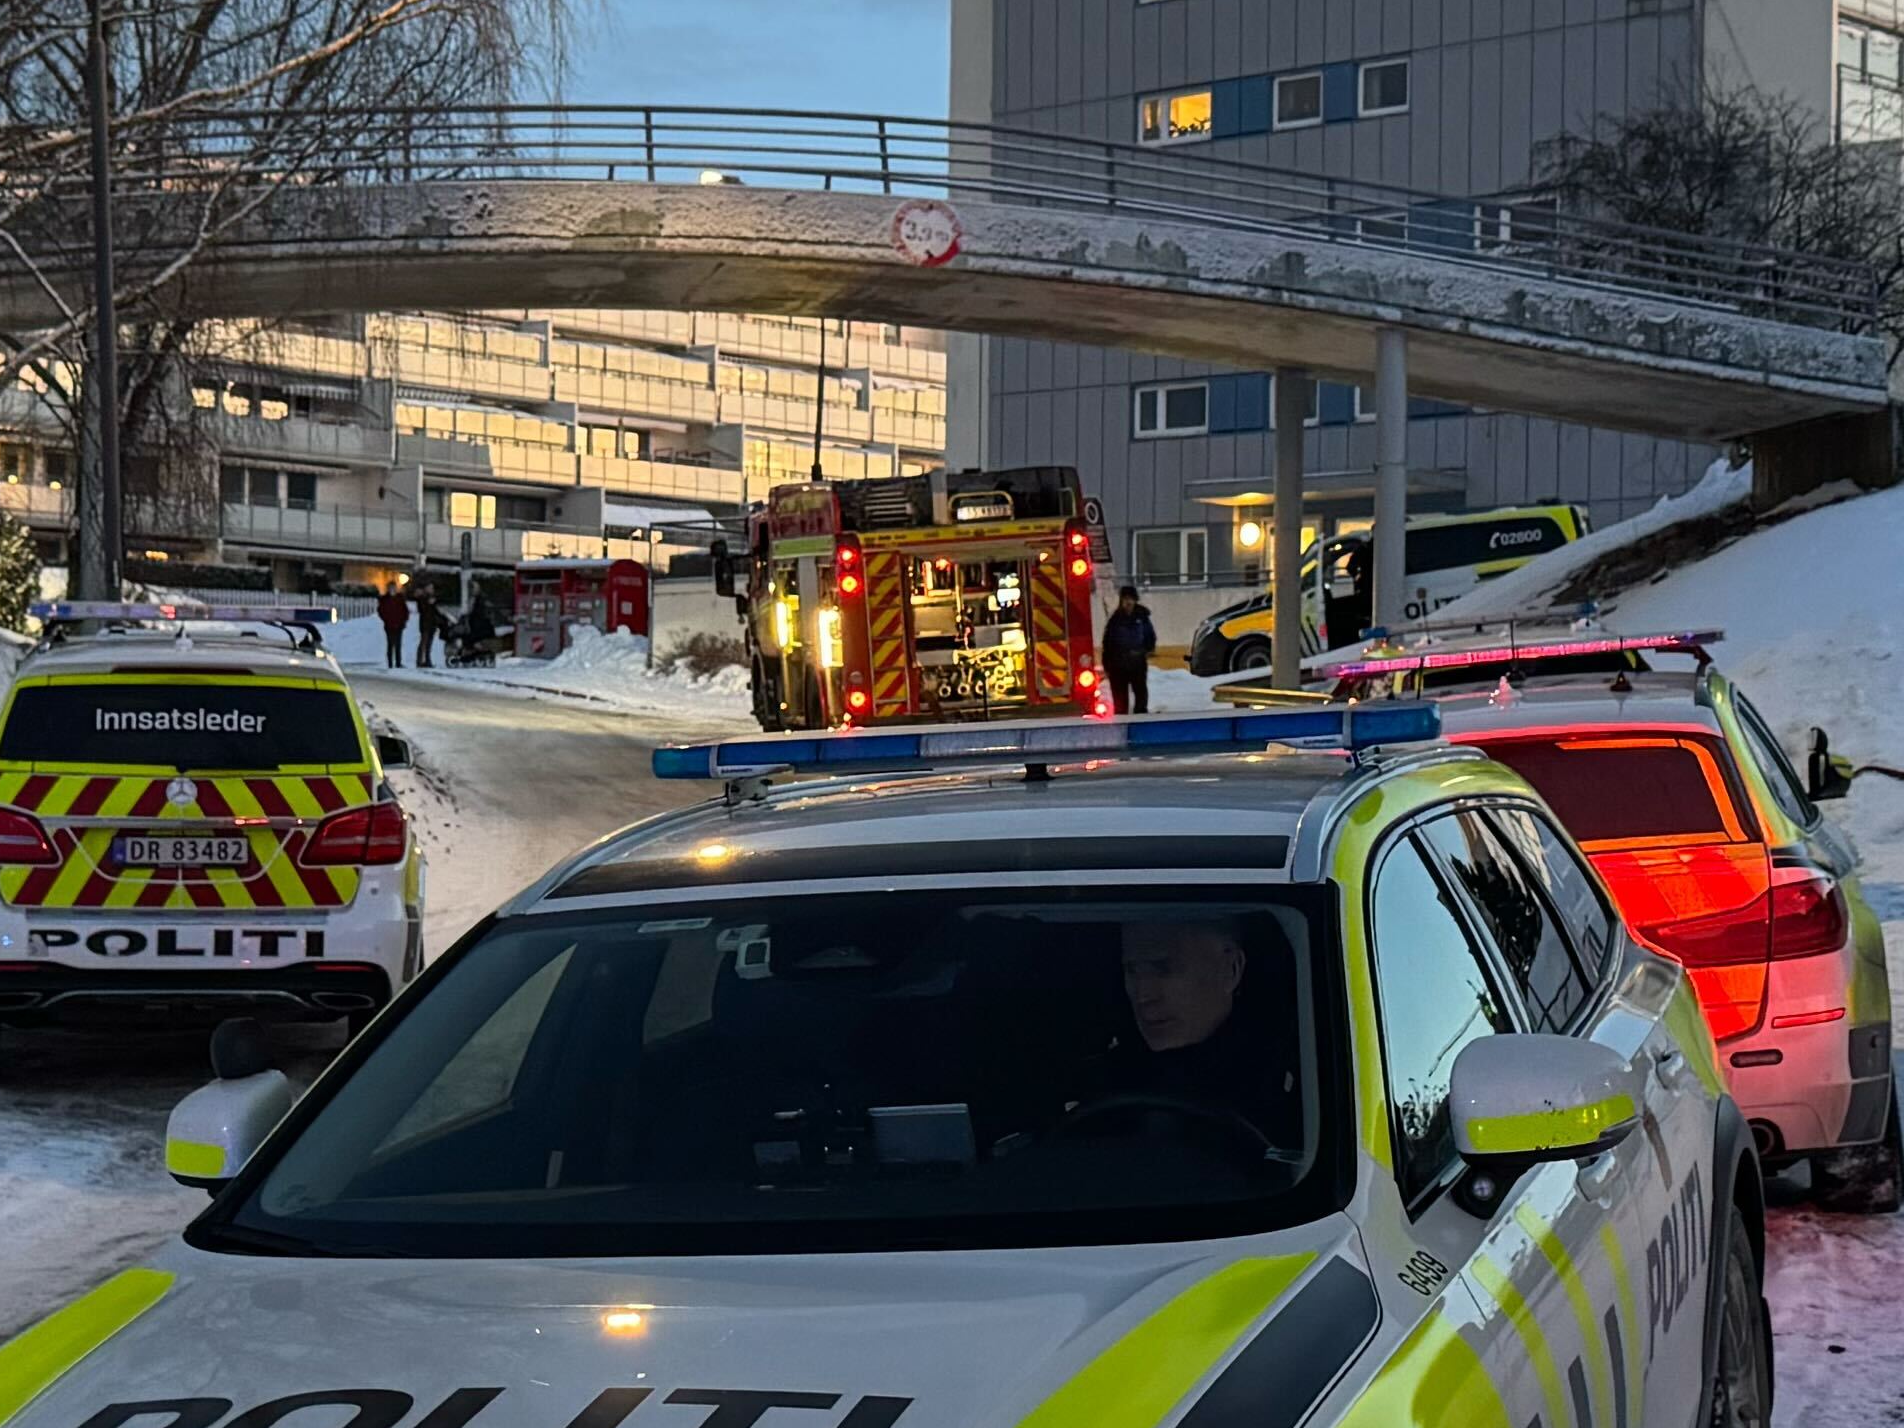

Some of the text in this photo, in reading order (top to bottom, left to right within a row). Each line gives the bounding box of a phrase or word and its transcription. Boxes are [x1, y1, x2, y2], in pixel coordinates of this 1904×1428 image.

[95, 706, 267, 735] Innsatsleder
[130, 840, 244, 861] DR 83482
[29, 927, 326, 957] POLITI
[1397, 1250, 1449, 1296] 6499
[1646, 1161, 1706, 1362] POLITI
